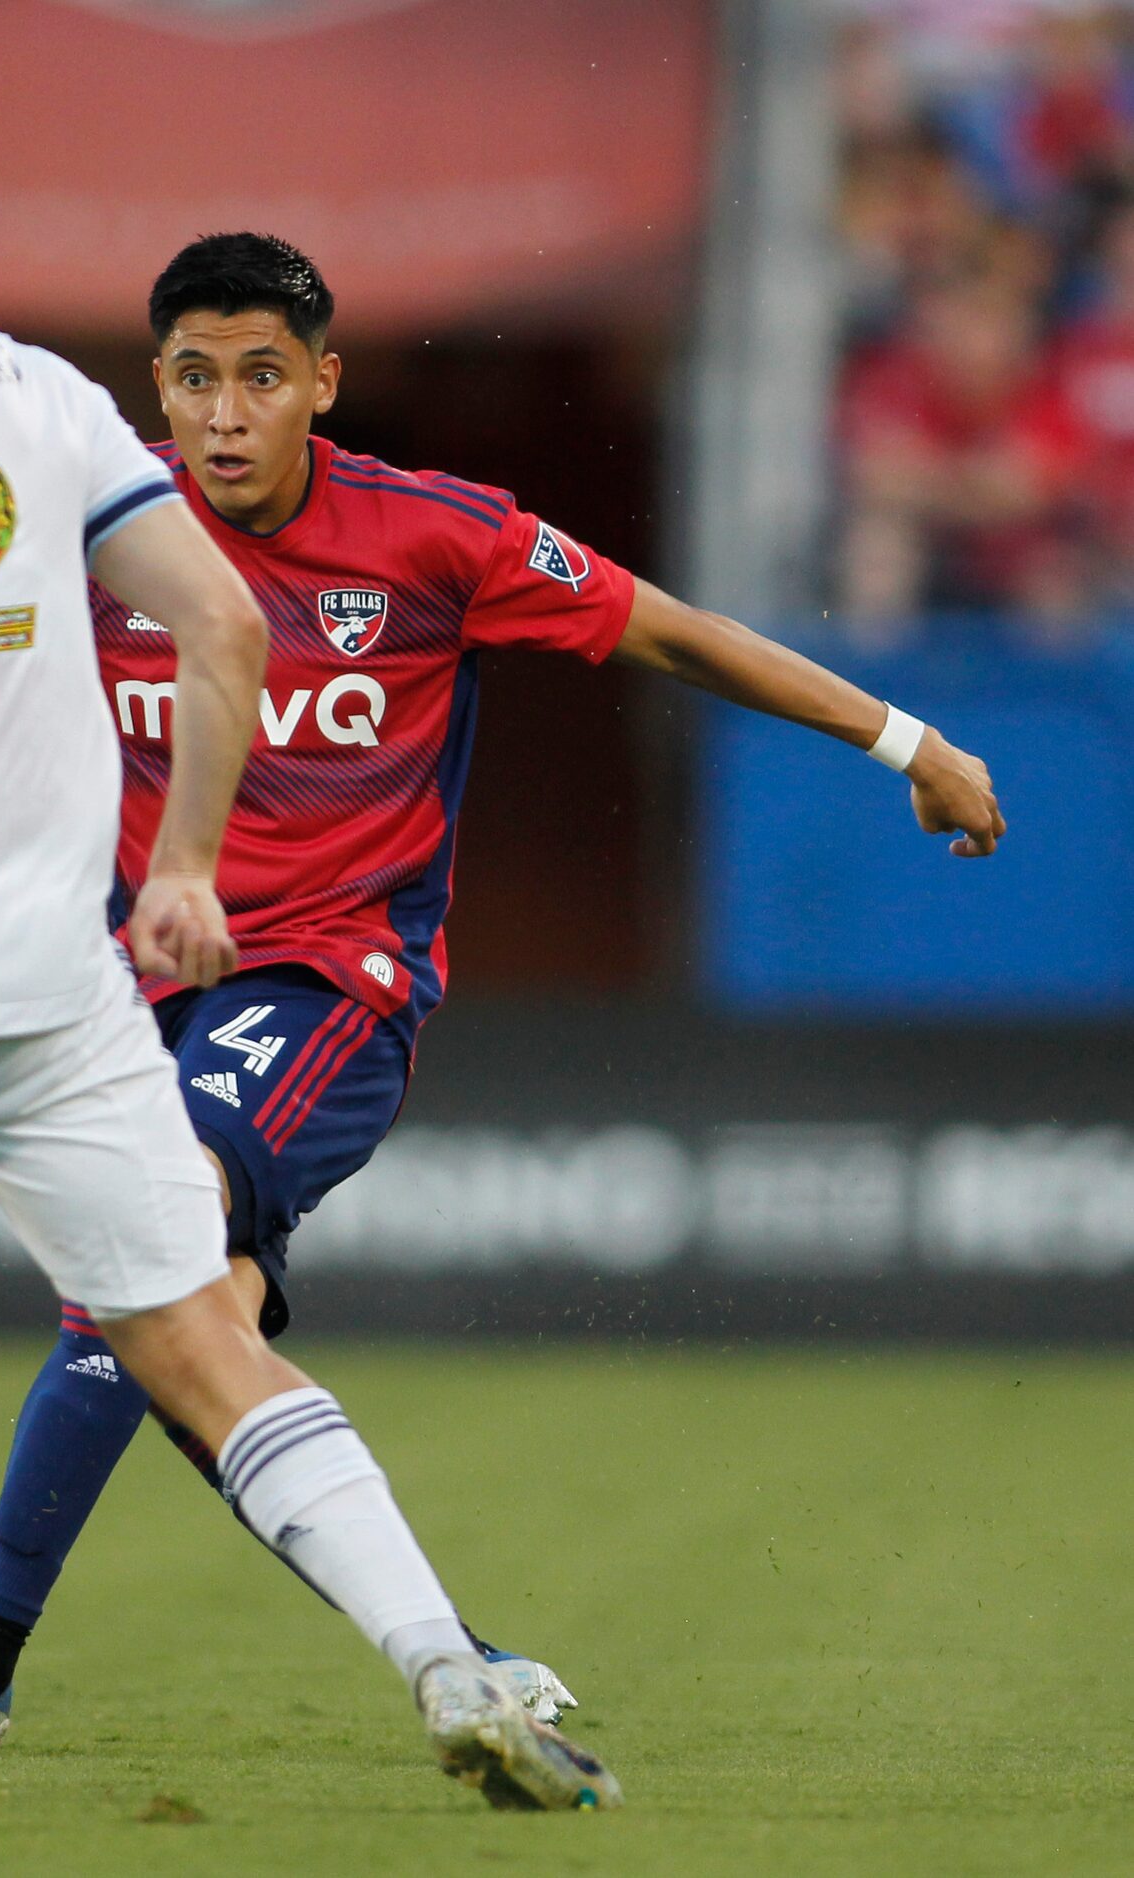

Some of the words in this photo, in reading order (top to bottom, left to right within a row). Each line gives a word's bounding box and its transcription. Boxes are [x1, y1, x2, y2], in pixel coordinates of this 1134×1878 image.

[535, 537, 554, 568] MLS
[324, 594, 338, 610] FC
[341, 593, 382, 610] DALLAS
[116, 673, 386, 747] mvQ
[208, 1004, 287, 1077] 4
[190, 1076, 242, 1108] adidas
[66, 1362, 119, 1382] adidas
